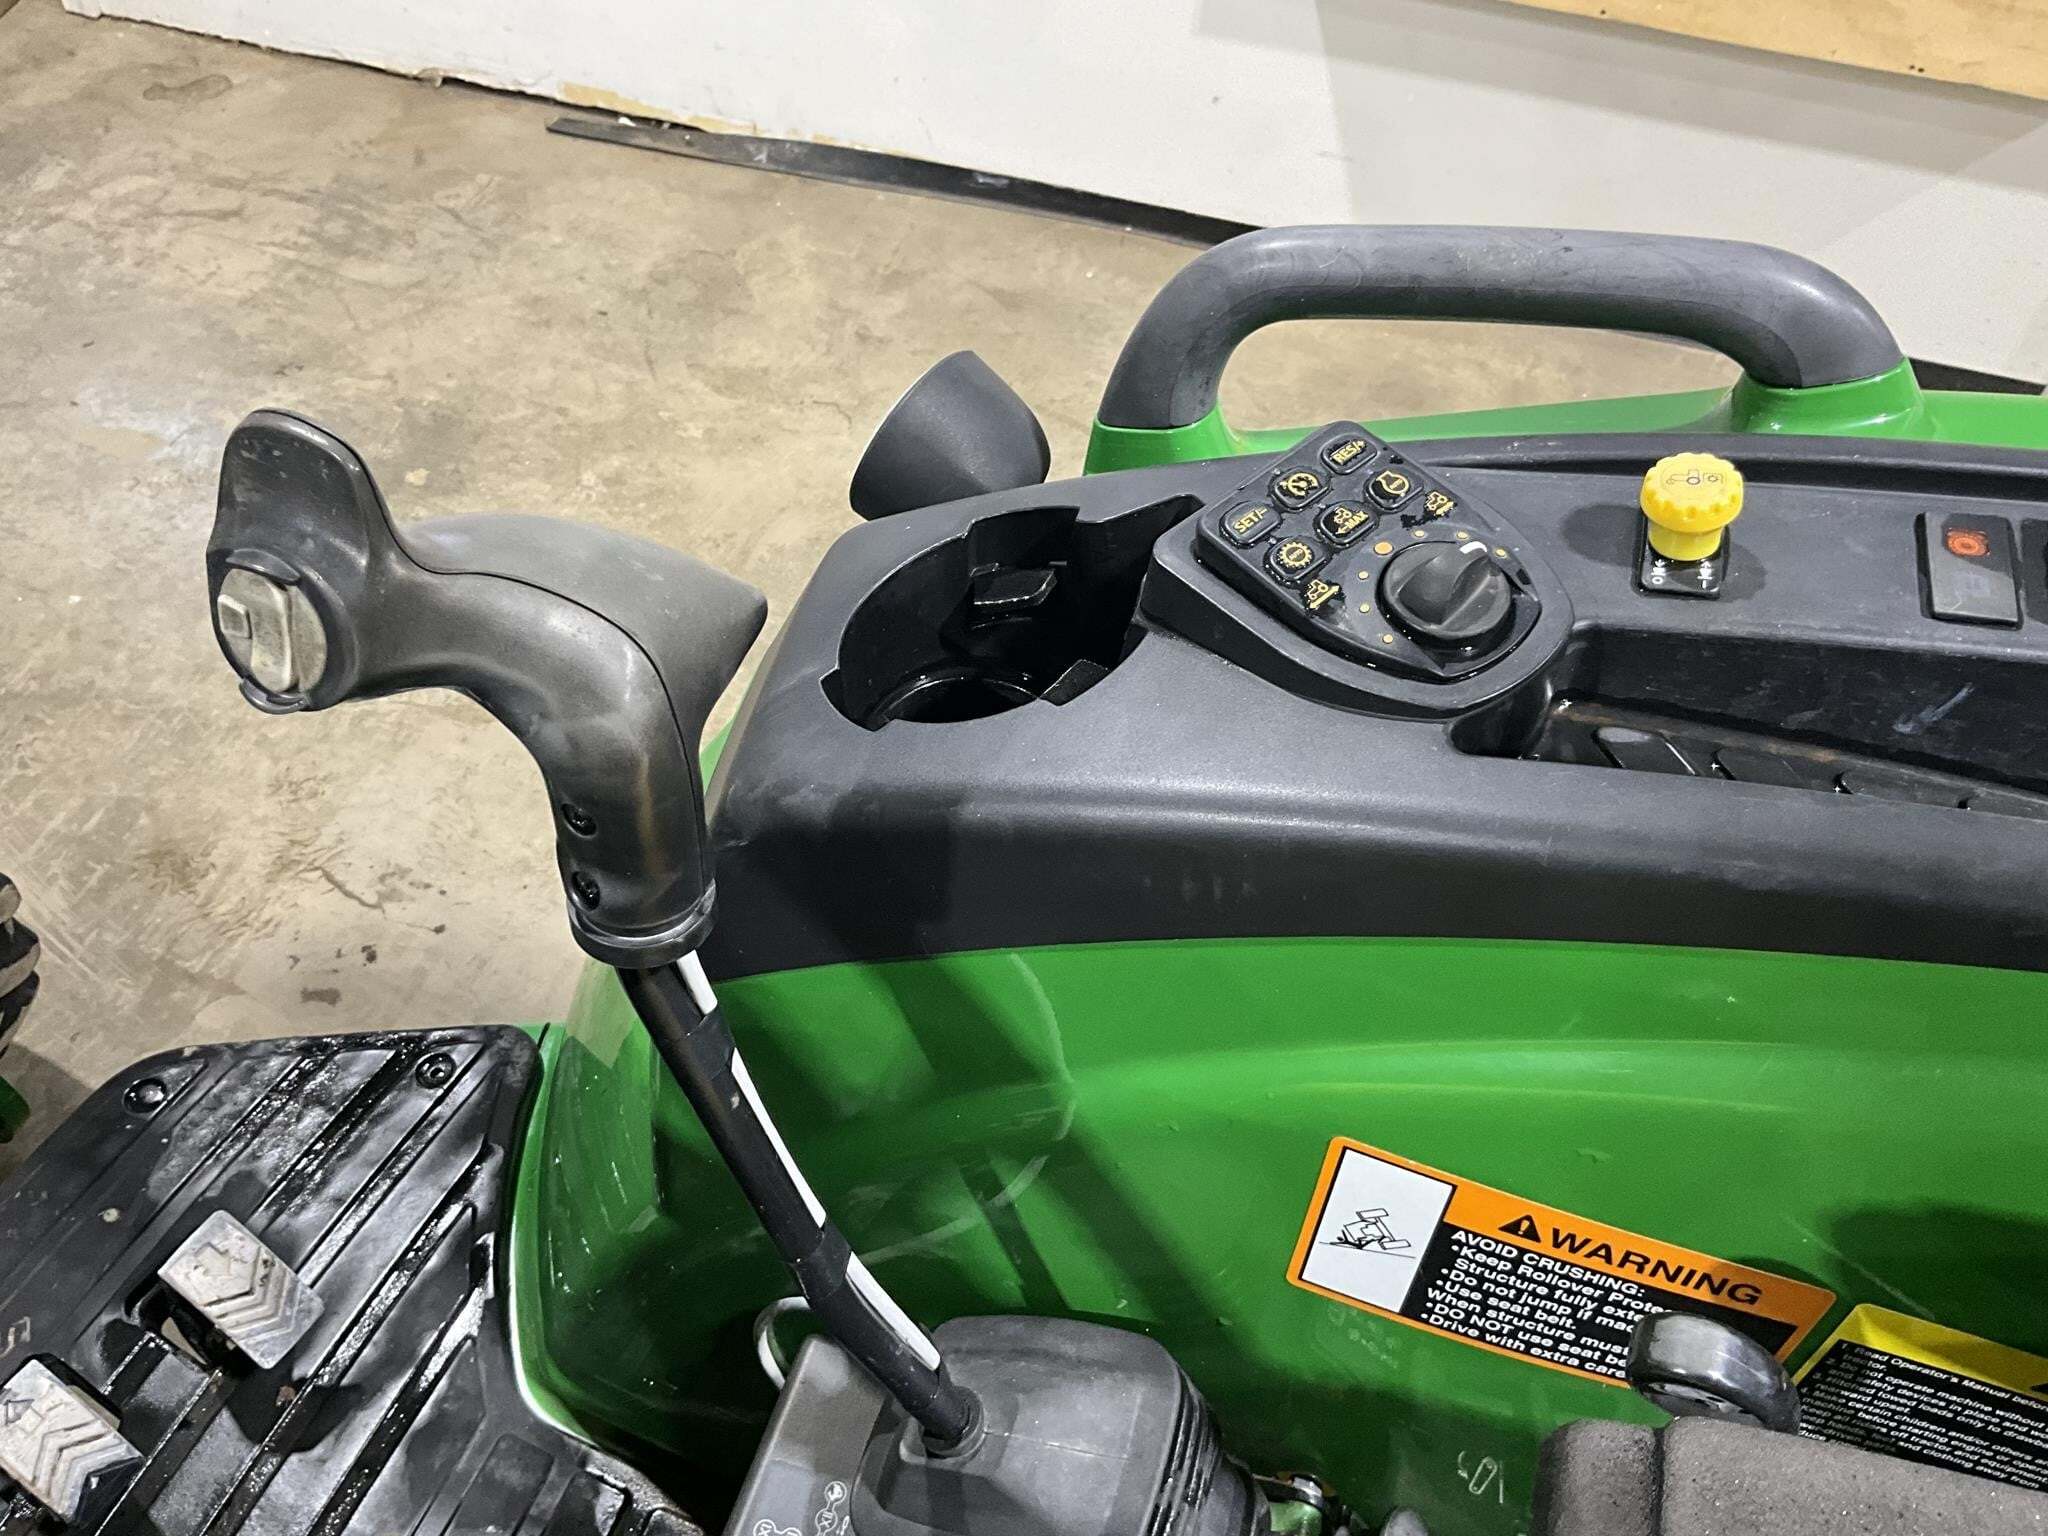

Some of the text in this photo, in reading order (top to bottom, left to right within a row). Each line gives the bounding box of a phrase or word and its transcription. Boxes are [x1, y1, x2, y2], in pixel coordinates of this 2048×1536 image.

[1451, 1230, 1645, 1297] AVOID CRUSHING:
[1455, 1258, 1644, 1322] Structure fully exte
[1460, 1246, 1673, 1314] Keep Rollover Prote
[1552, 1228, 1762, 1305] WARNING
[1427, 1287, 1481, 1313] When
[1485, 1309, 1576, 1341] structure
[1445, 1280, 1577, 1330] Use seat belt.
[1449, 1270, 1634, 1333] Do not jump if mac
[1429, 1314, 1480, 1338] Drive
[1485, 1333, 1525, 1351] with
[1530, 1347, 1580, 1367] extra
[1434, 1303, 1627, 1368] DO NOT use seat be
[1854, 1346, 1890, 1361] Read
[1890, 1358, 1959, 1384] Operator's
[1961, 1379, 2012, 1399] Manual
[2012, 1395, 2048, 1412] befor
[1857, 1377, 1895, 1392] safety
[1897, 1388, 1947, 1407] devices
[1949, 1403, 1962, 1412] in
[1963, 1408, 2000, 1424] place
[2002, 1421, 2029, 1432] and
[1861, 1369, 1884, 1379] not
[1885, 1375, 1935, 1395] operate
[1936, 1390, 1993, 1412] machine
[1995, 1409, 2046, 1429] without
[1873, 1400, 1911, 1414] upset.
[1848, 1401, 1892, 1417] certain
[1894, 1415, 1946, 1434] children
[1948, 1431, 1990, 1447] and/or
[1991, 1445, 2034, 1460] others
[1857, 1412, 1897, 1427] before
[1899, 1424, 1949, 1443] starting
[1951, 1440, 1994, 1456] engine
[2012, 1460, 2048, 1475] opera
[1878, 1391, 1918, 1406] towed
[1918, 1403, 1954, 1418] loads
[1956, 1416, 1986, 1429] only
[1987, 1424, 2001, 1433] to
[2003, 1430, 2048, 1449] drawba
[1890, 1430, 1909, 1439] off
[1911, 1436, 1952, 1451] tractor
[1954, 1450, 1980, 1460] and
[1898, 1441, 1921, 1451] and
[1923, 1449, 1974, 1468] clothing
[1976, 1465, 2008, 1479] away
[2010, 1475, 2040, 1489] from
